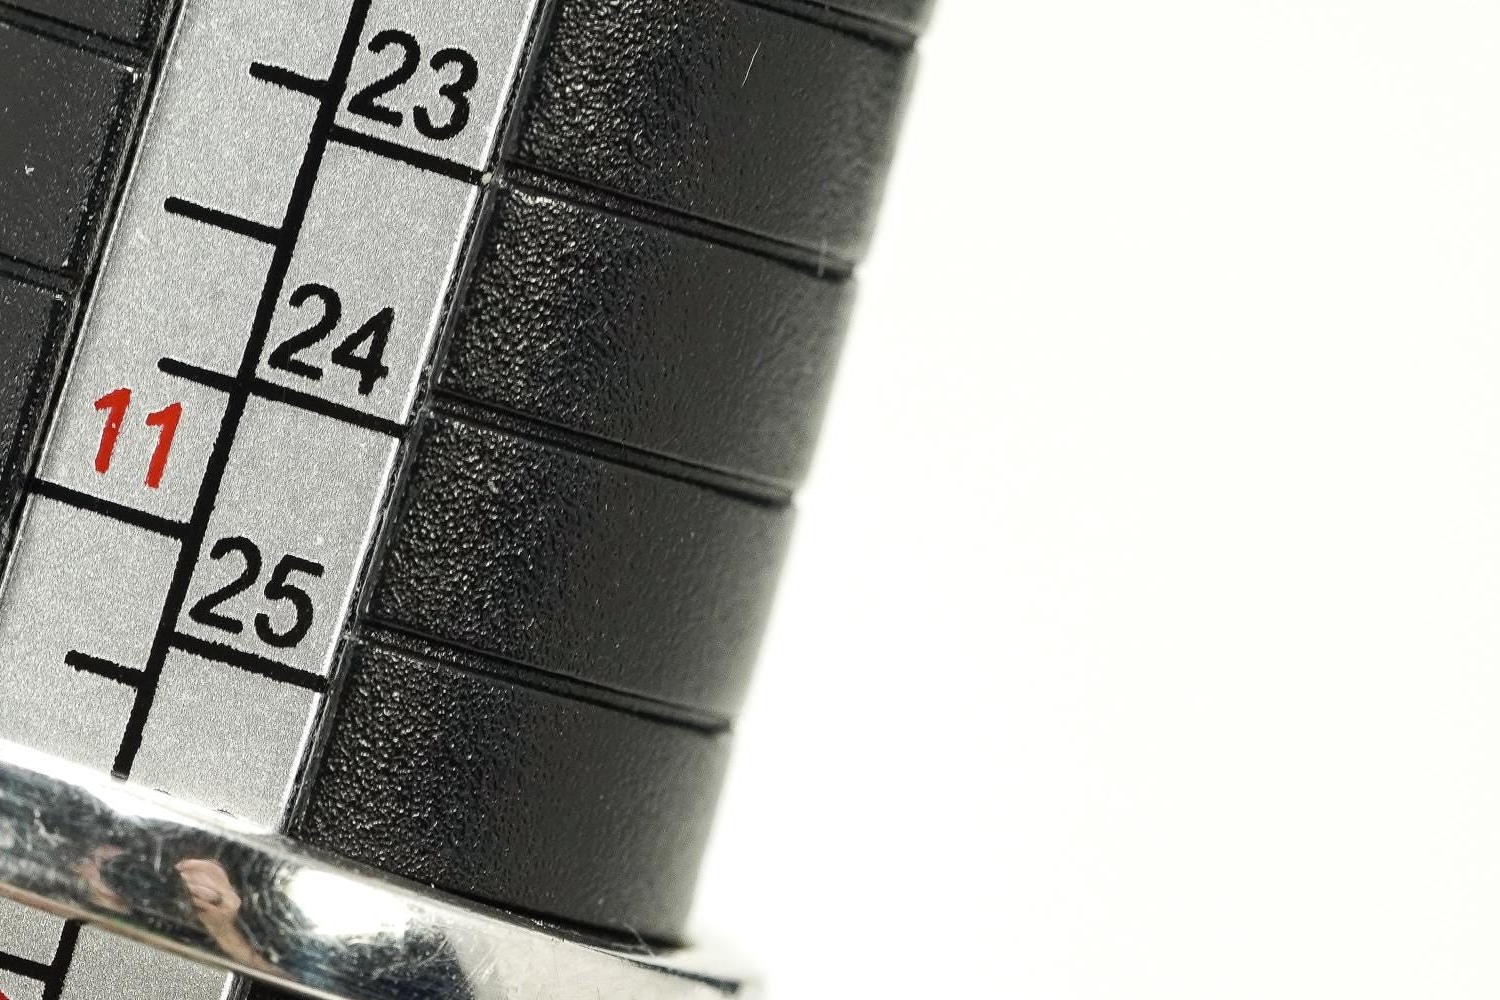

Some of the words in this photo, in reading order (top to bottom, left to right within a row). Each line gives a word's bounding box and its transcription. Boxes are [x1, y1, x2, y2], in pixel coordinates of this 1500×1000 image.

[346, 28, 479, 142] 23
[267, 282, 396, 398] 24
[94, 387, 184, 489] 11
[188, 535, 325, 650] 25
